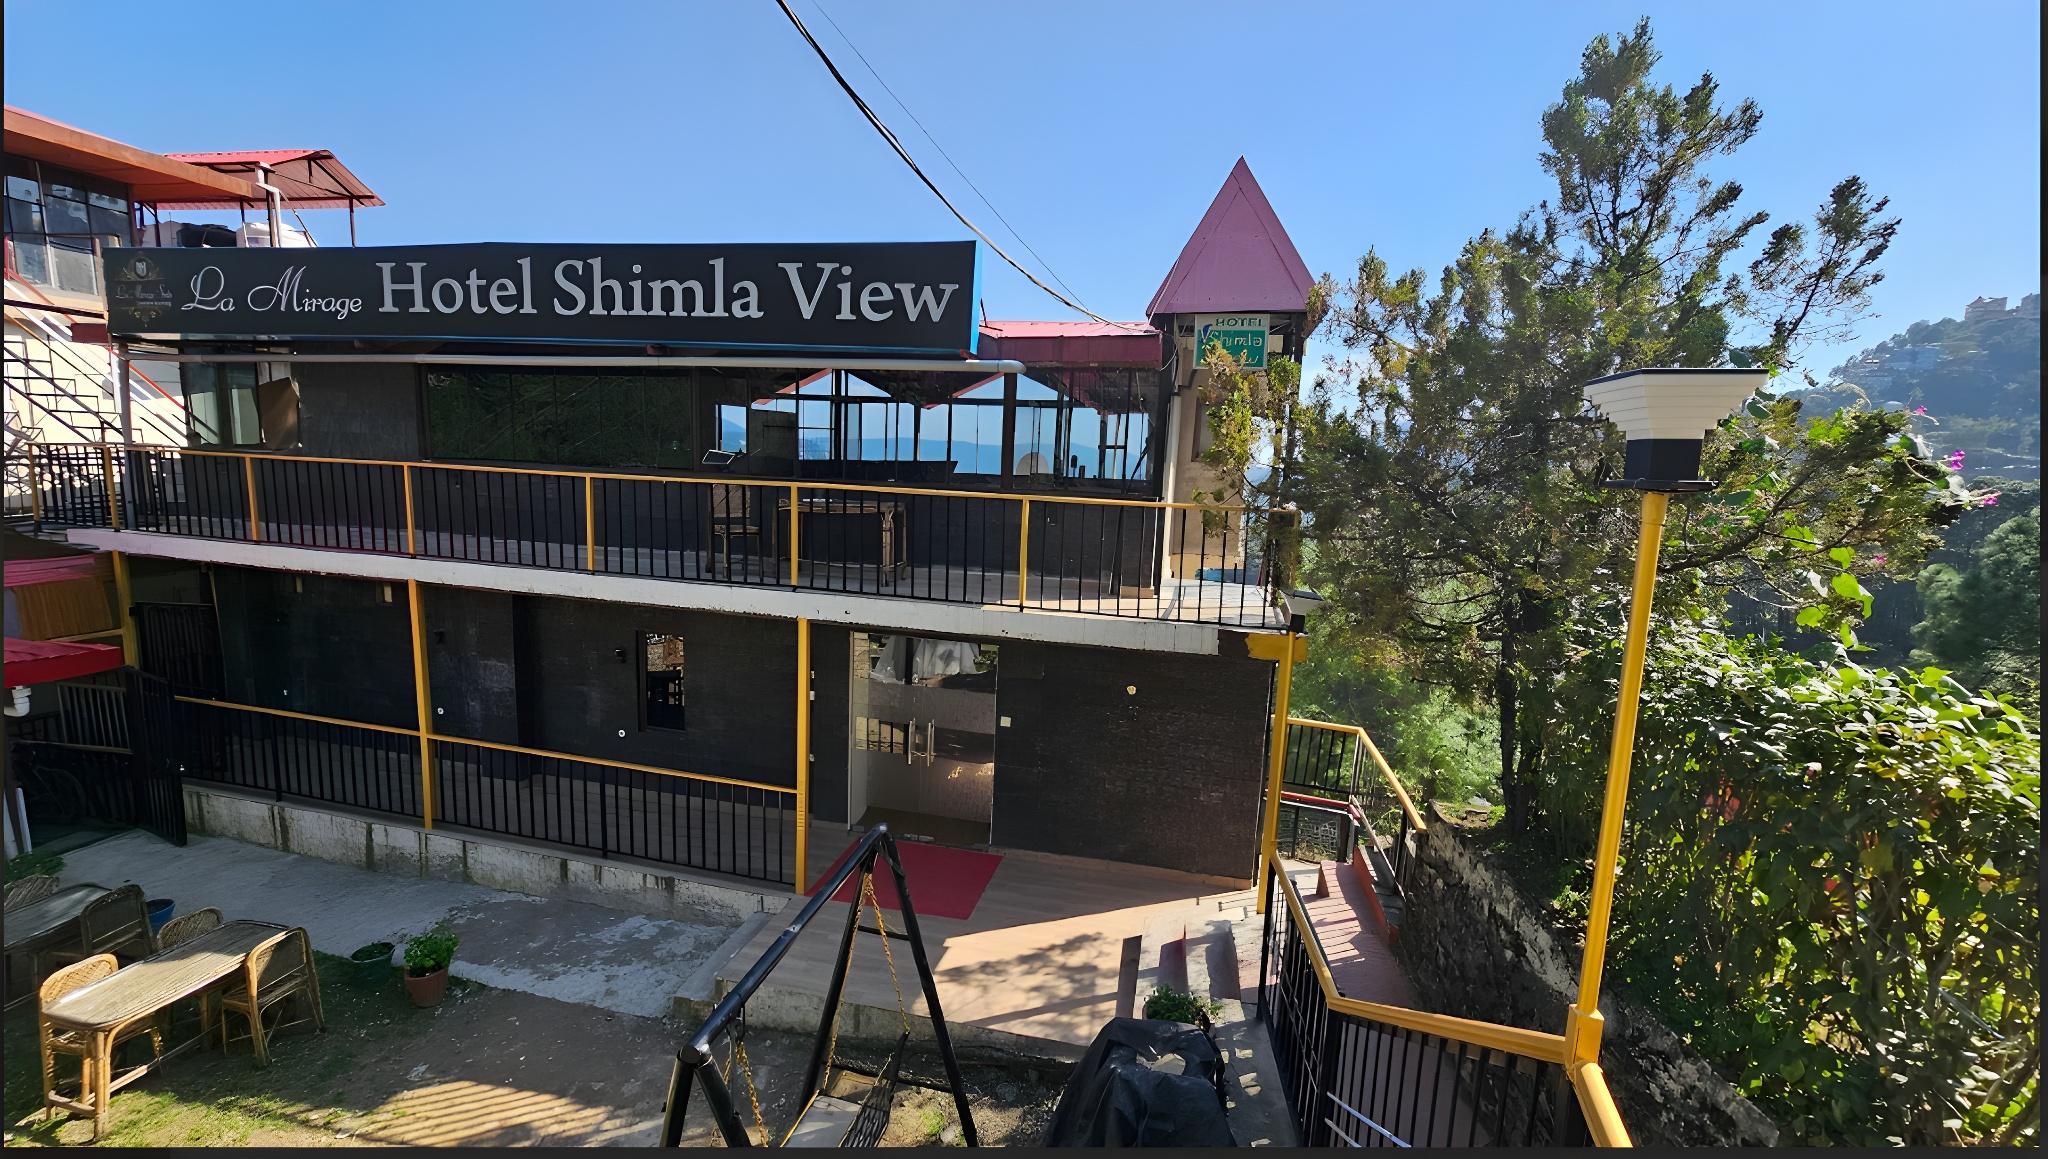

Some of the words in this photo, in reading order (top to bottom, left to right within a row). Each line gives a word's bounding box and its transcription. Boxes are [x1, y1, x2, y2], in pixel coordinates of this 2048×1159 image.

[181, 266, 235, 311] La
[248, 266, 362, 319] Mirage
[376, 257, 537, 314] Hotel
[554, 257, 764, 318] Shimla
[778, 263, 958, 322] View
[1215, 317, 1262, 327] HOTEL
